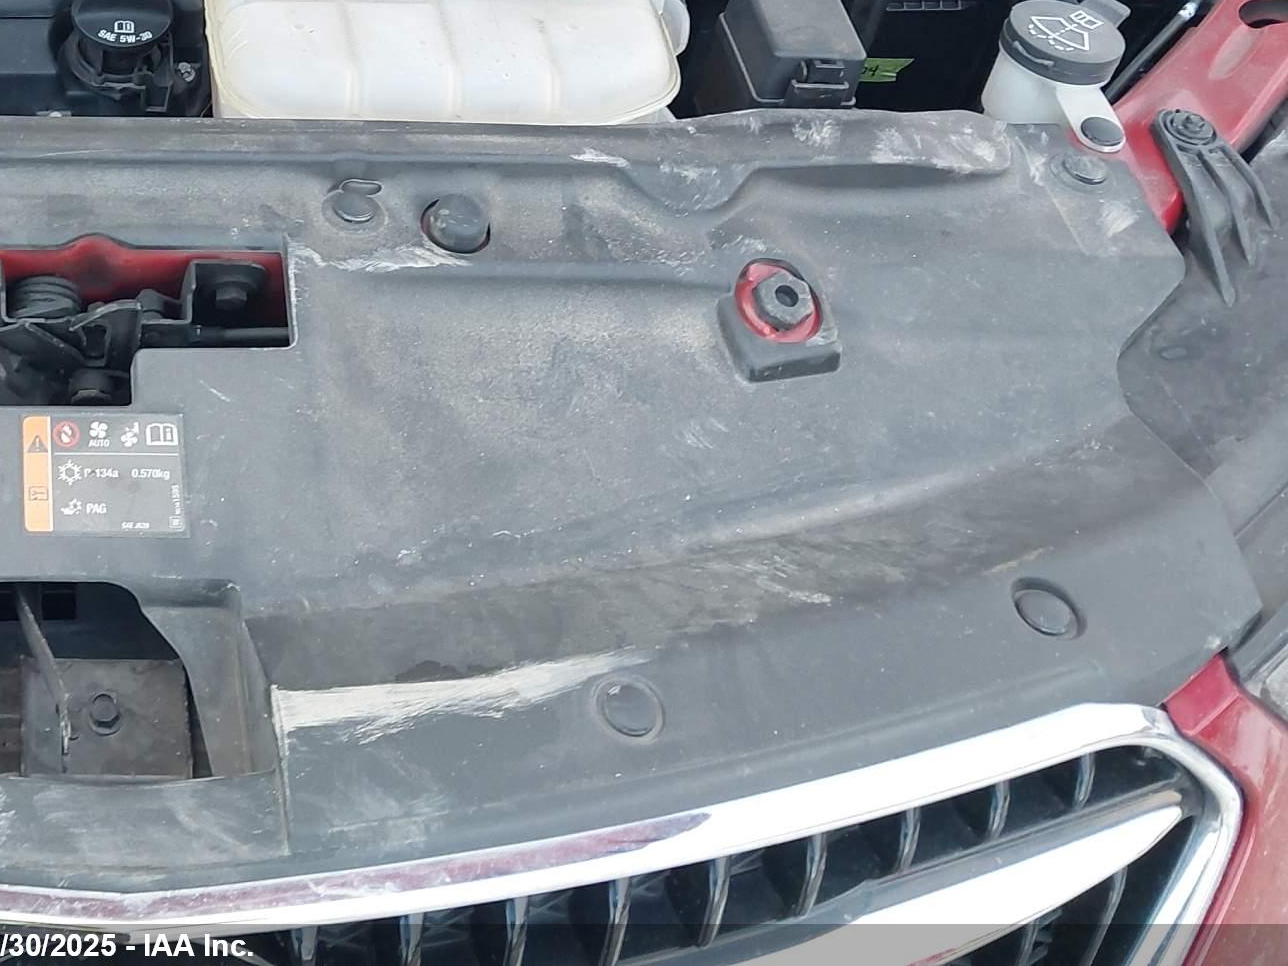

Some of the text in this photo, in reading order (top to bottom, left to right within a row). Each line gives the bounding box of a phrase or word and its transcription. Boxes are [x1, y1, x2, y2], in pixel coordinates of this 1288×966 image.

[98, 30, 153, 43] SAE 5W-30
[88, 439, 110, 447] AUTO
[86, 503, 107, 515] PAG
